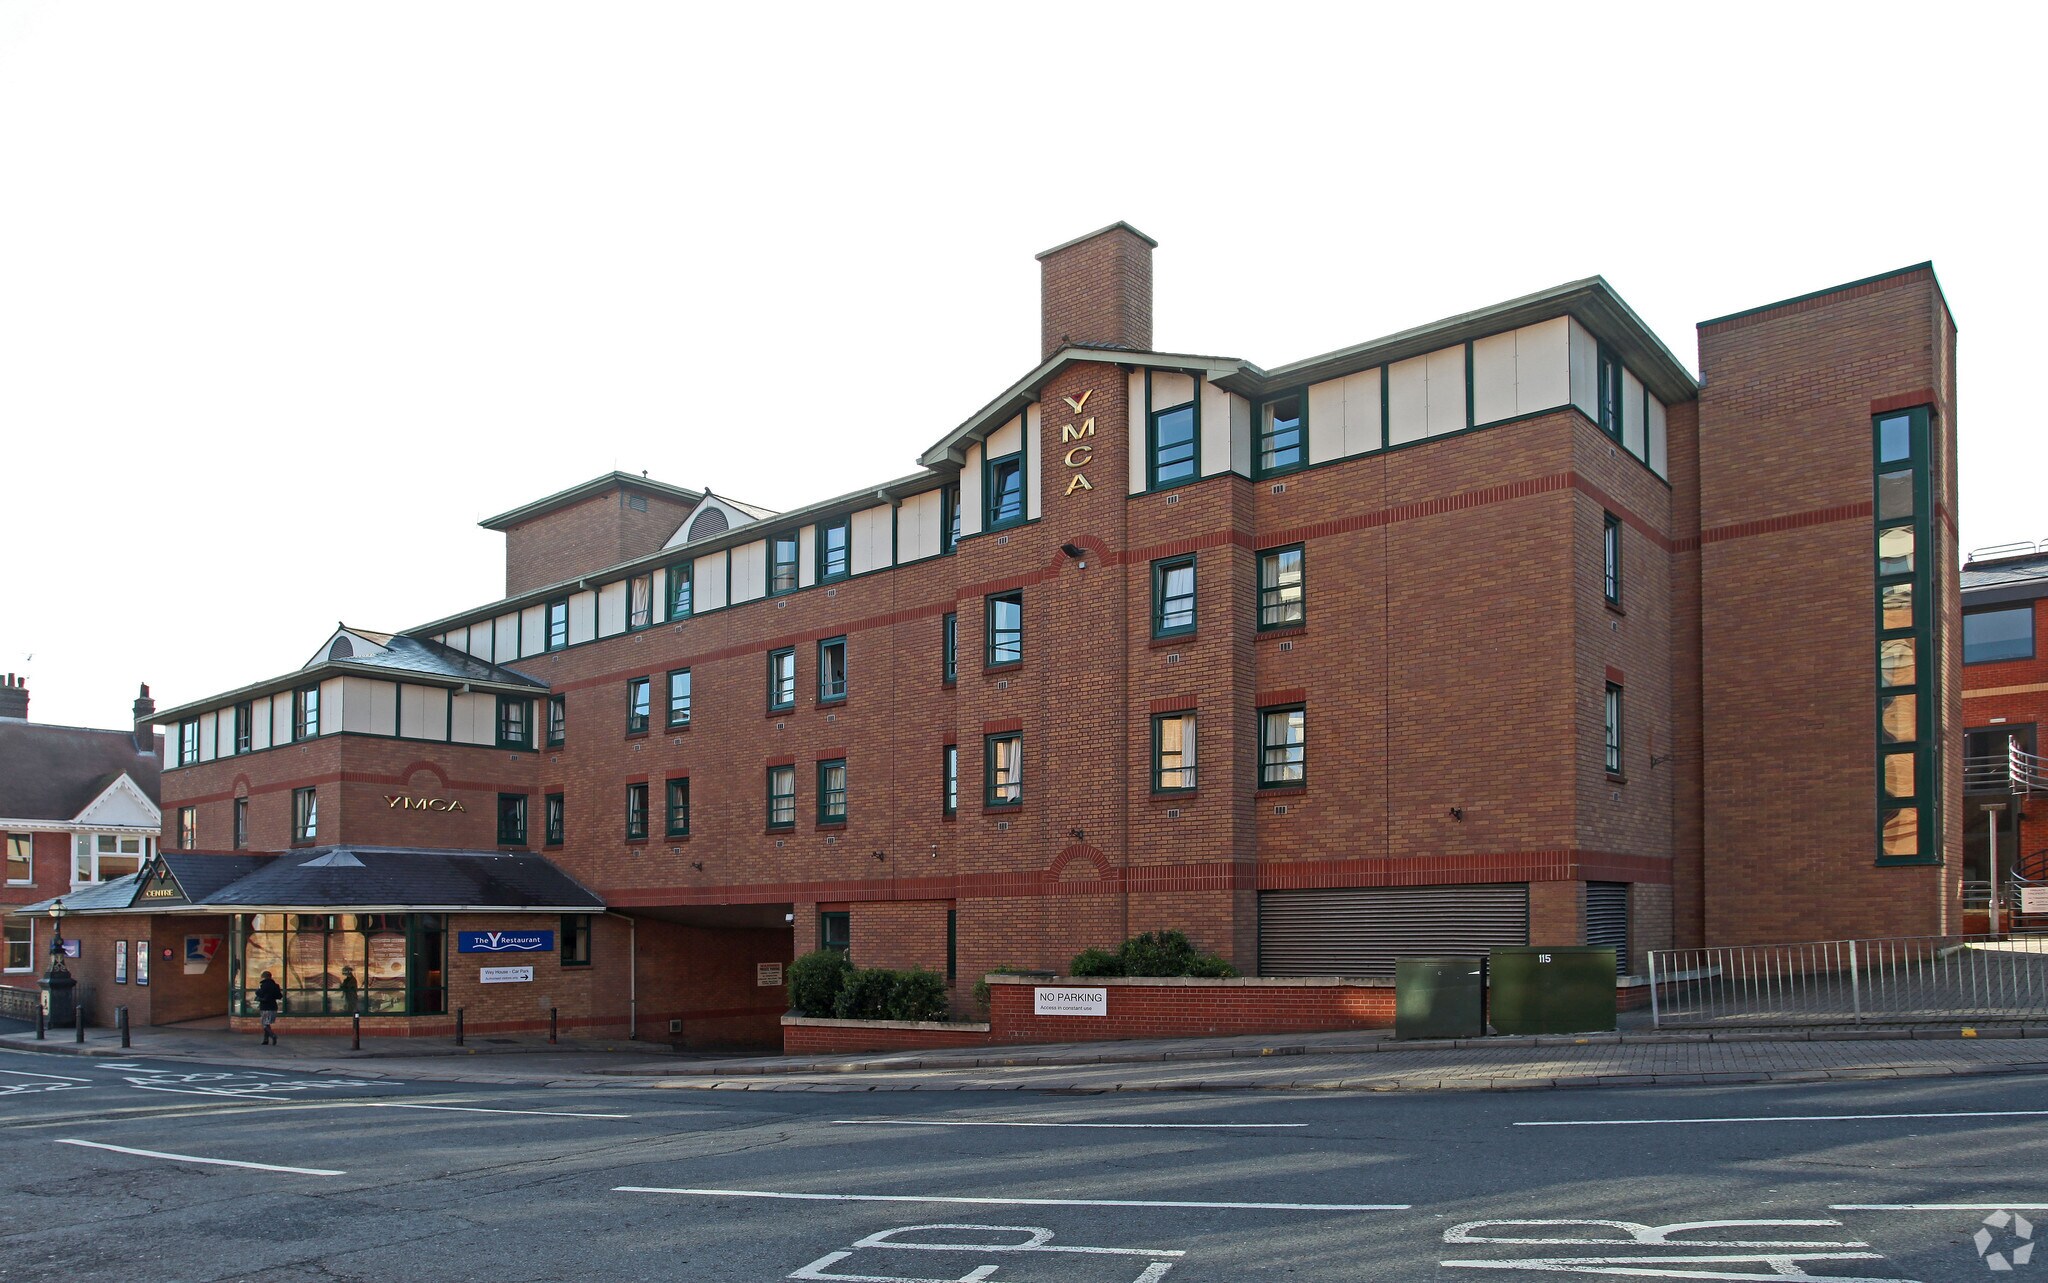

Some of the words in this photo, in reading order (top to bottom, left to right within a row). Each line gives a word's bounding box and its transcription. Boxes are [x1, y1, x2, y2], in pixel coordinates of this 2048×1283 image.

[1062, 388, 1095, 496] YMCA
[384, 795, 467, 813] YMCA
[146, 889, 174, 897] CENTRE
[487, 932, 502, 947] Y
[1538, 954, 1551, 963] 115
[1039, 993, 1055, 1001] NO
[1057, 993, 1102, 1002] PARKING
